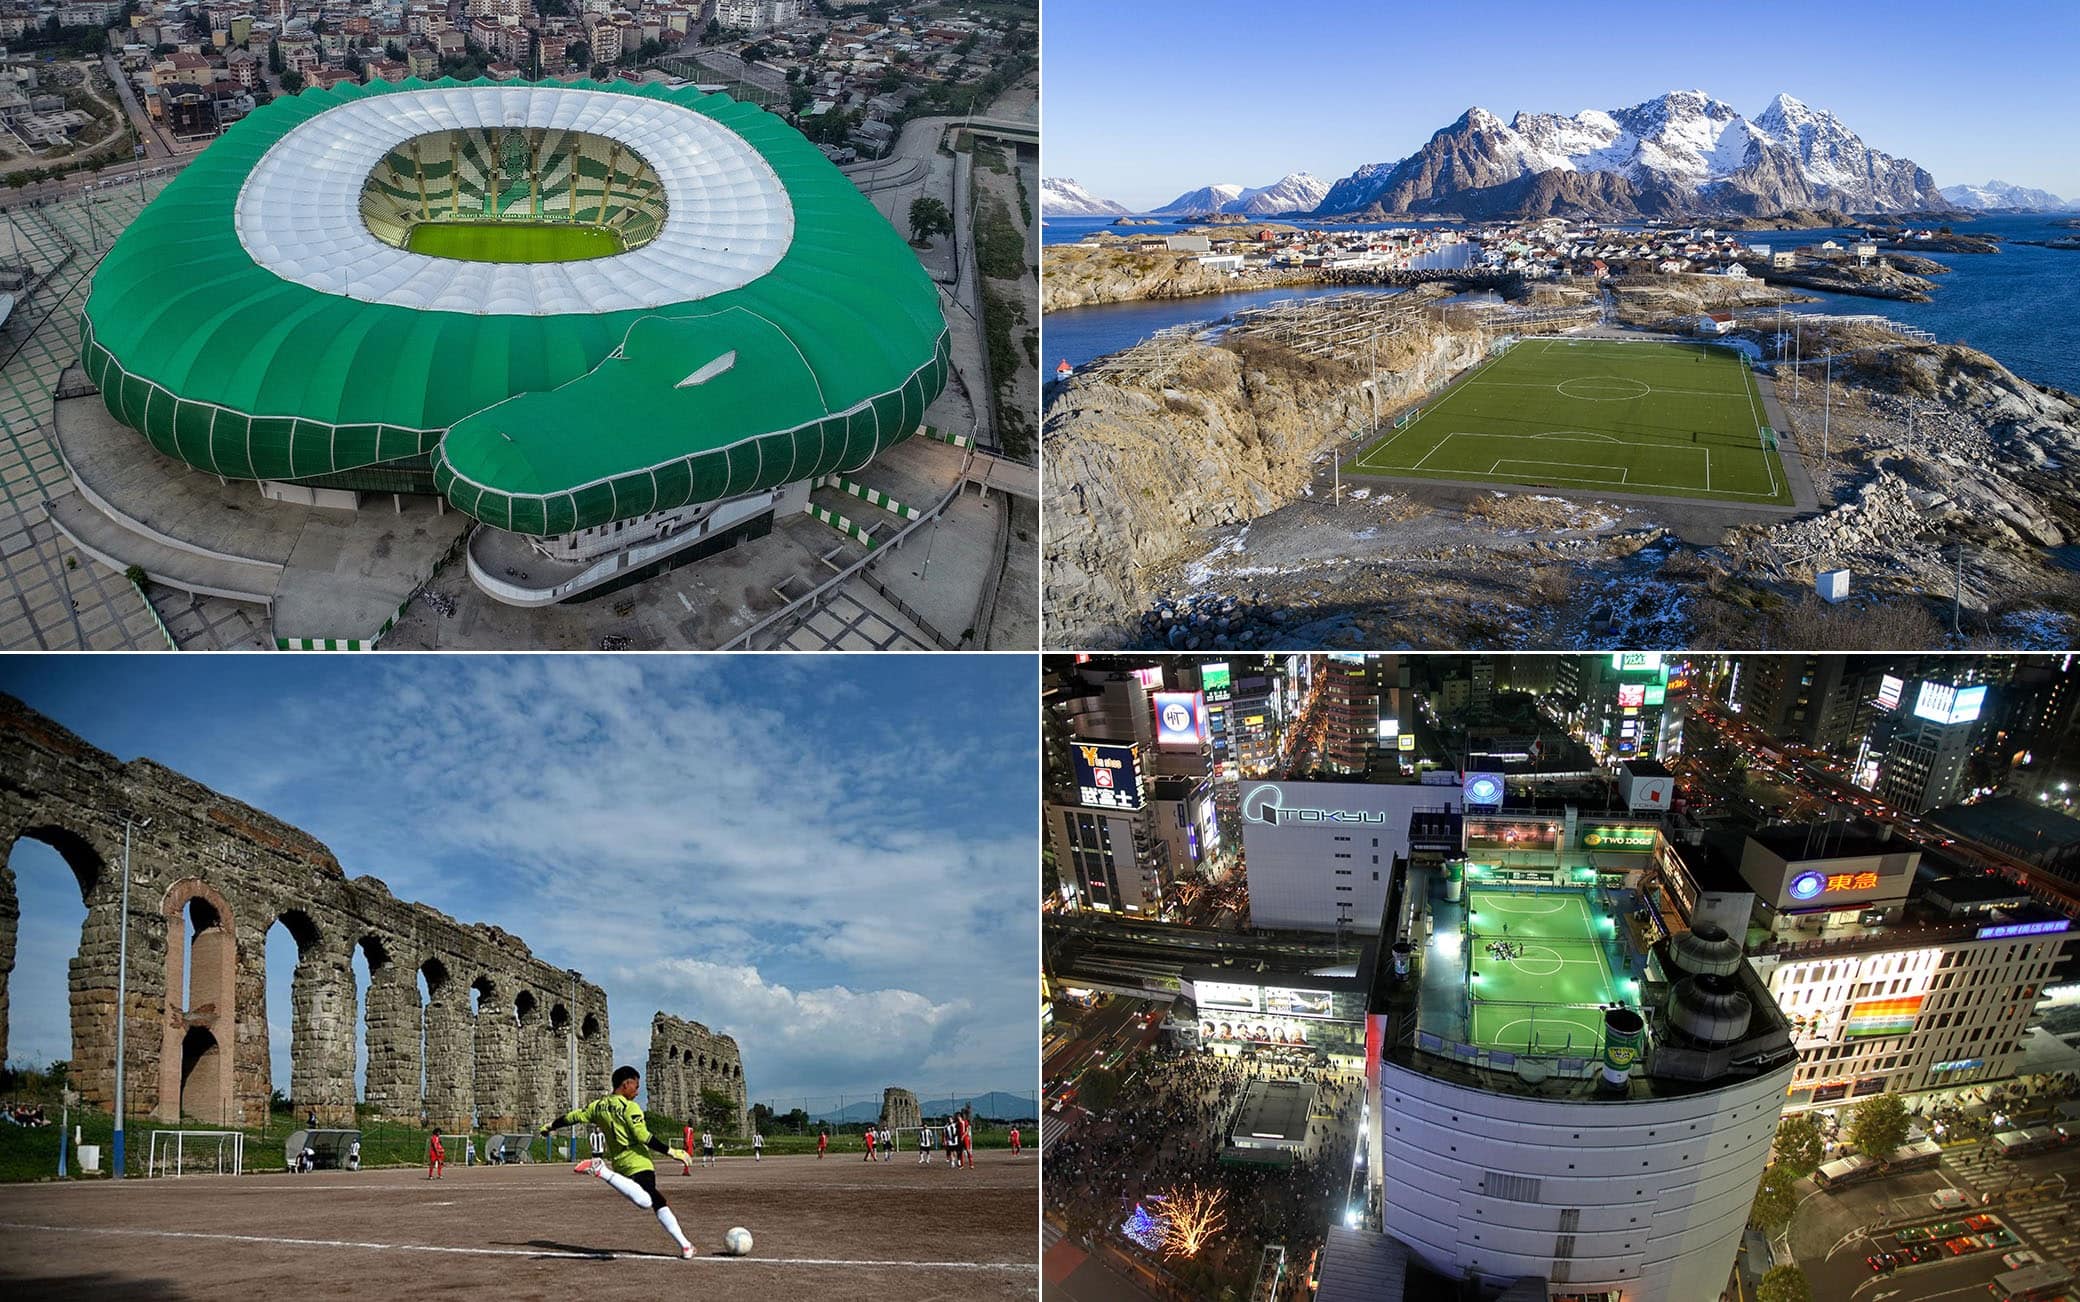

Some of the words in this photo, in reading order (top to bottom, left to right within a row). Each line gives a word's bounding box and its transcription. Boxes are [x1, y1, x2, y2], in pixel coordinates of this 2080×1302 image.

[1277, 808, 1386, 823] TOKYU
[1626, 837, 1653, 845] DOGS
[1825, 872, 1878, 892] 東急
